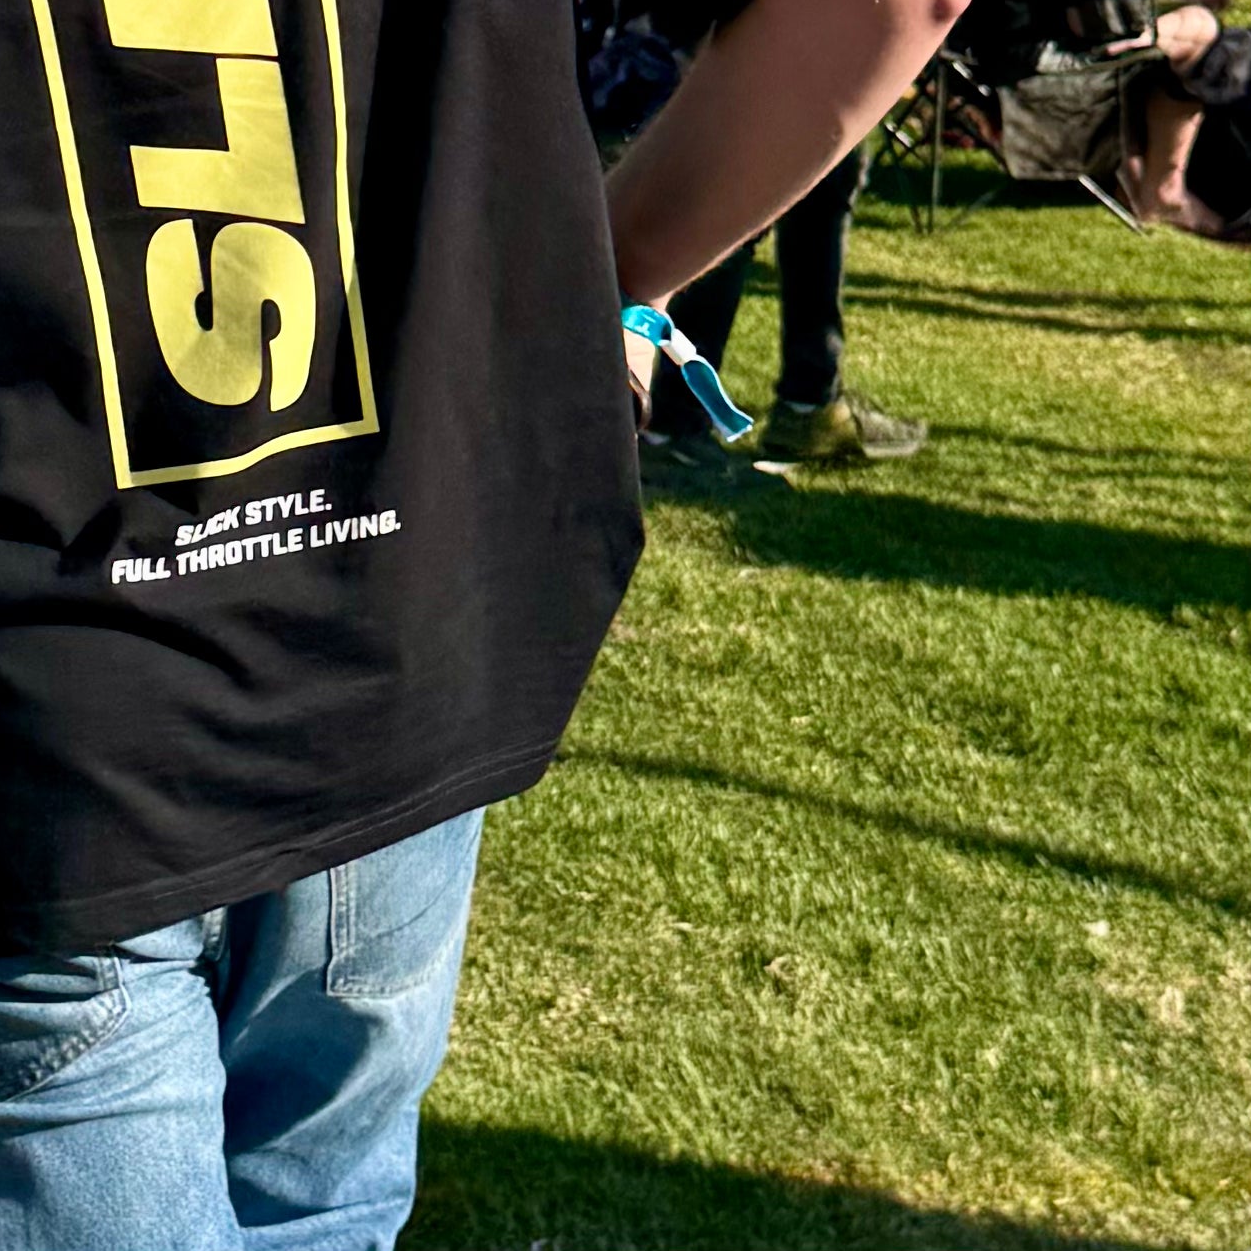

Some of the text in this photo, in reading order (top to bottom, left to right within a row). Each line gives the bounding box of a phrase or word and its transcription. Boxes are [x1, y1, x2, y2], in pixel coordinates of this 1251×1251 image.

[244, 488, 333, 525] STYLE.
[111, 509, 402, 585] FULL THROTTLE LIVING.
